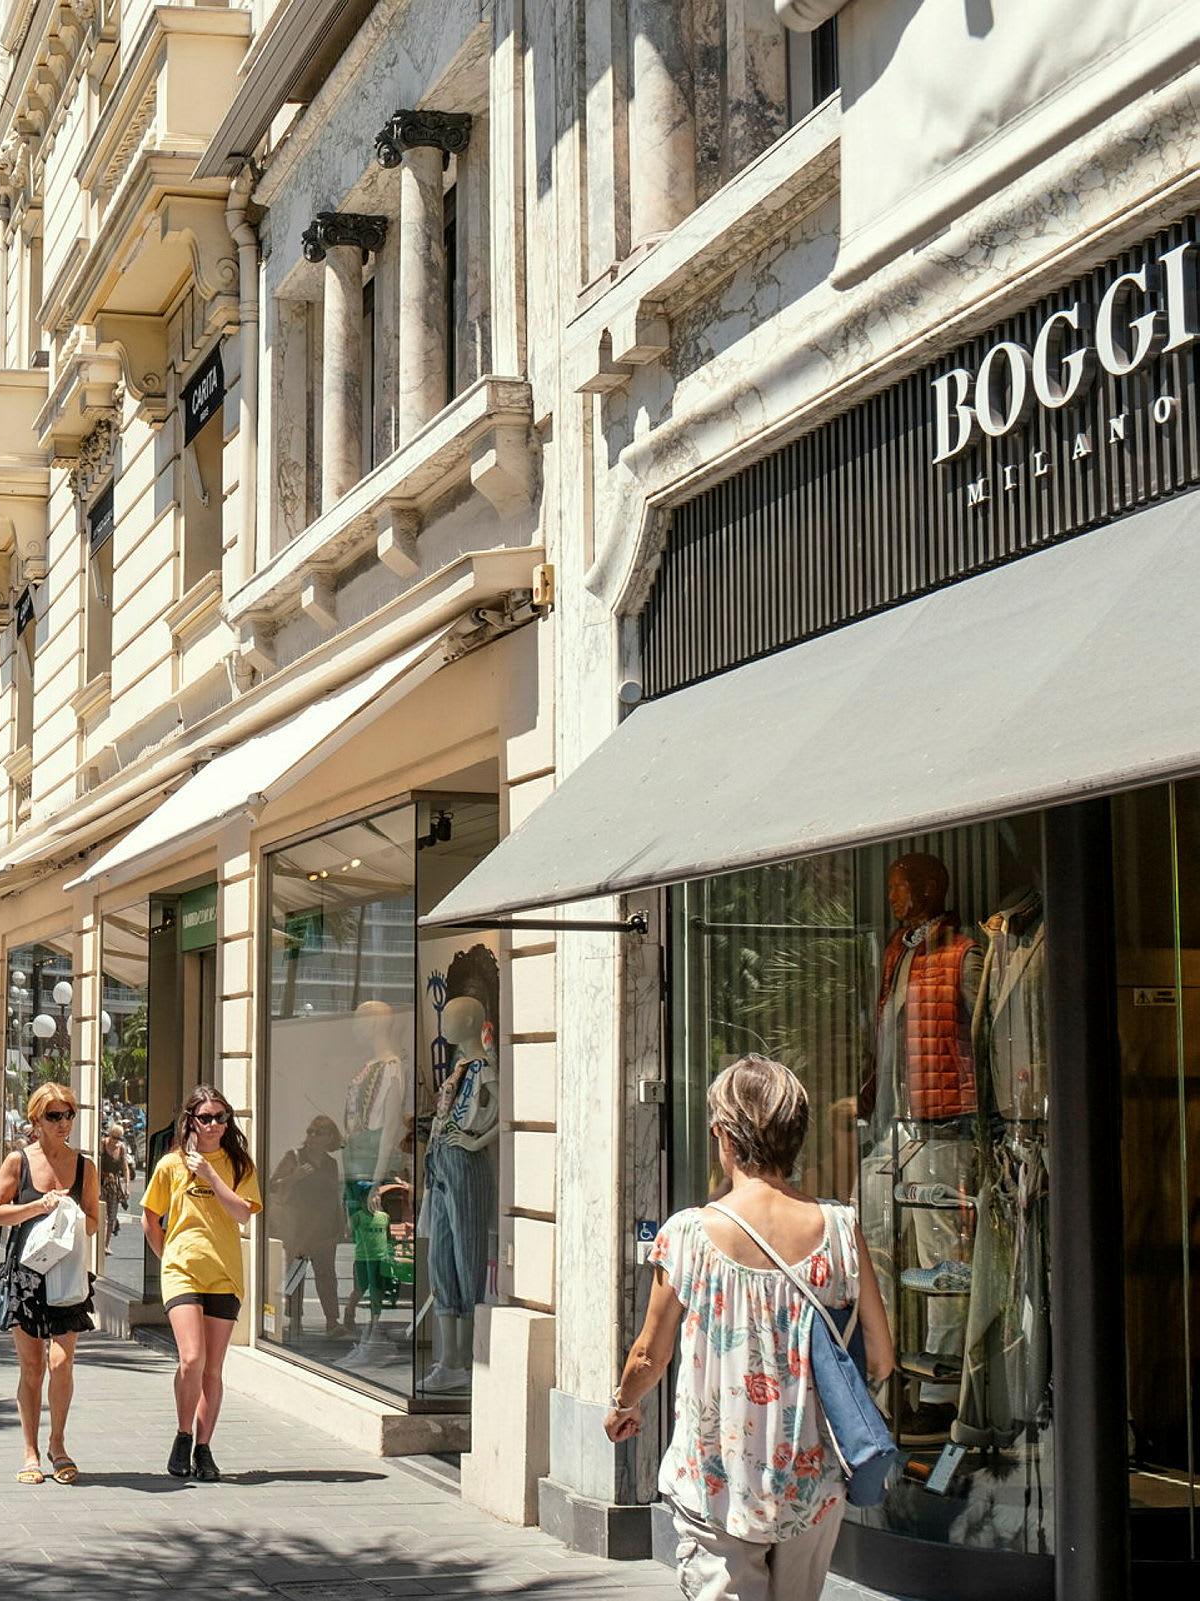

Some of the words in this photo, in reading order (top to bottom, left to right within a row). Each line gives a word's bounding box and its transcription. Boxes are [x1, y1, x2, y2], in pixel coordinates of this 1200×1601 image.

[191, 365, 218, 415] CARITA
[931, 241, 1200, 464] BOGGI
[967, 396, 1176, 507] MILANO
